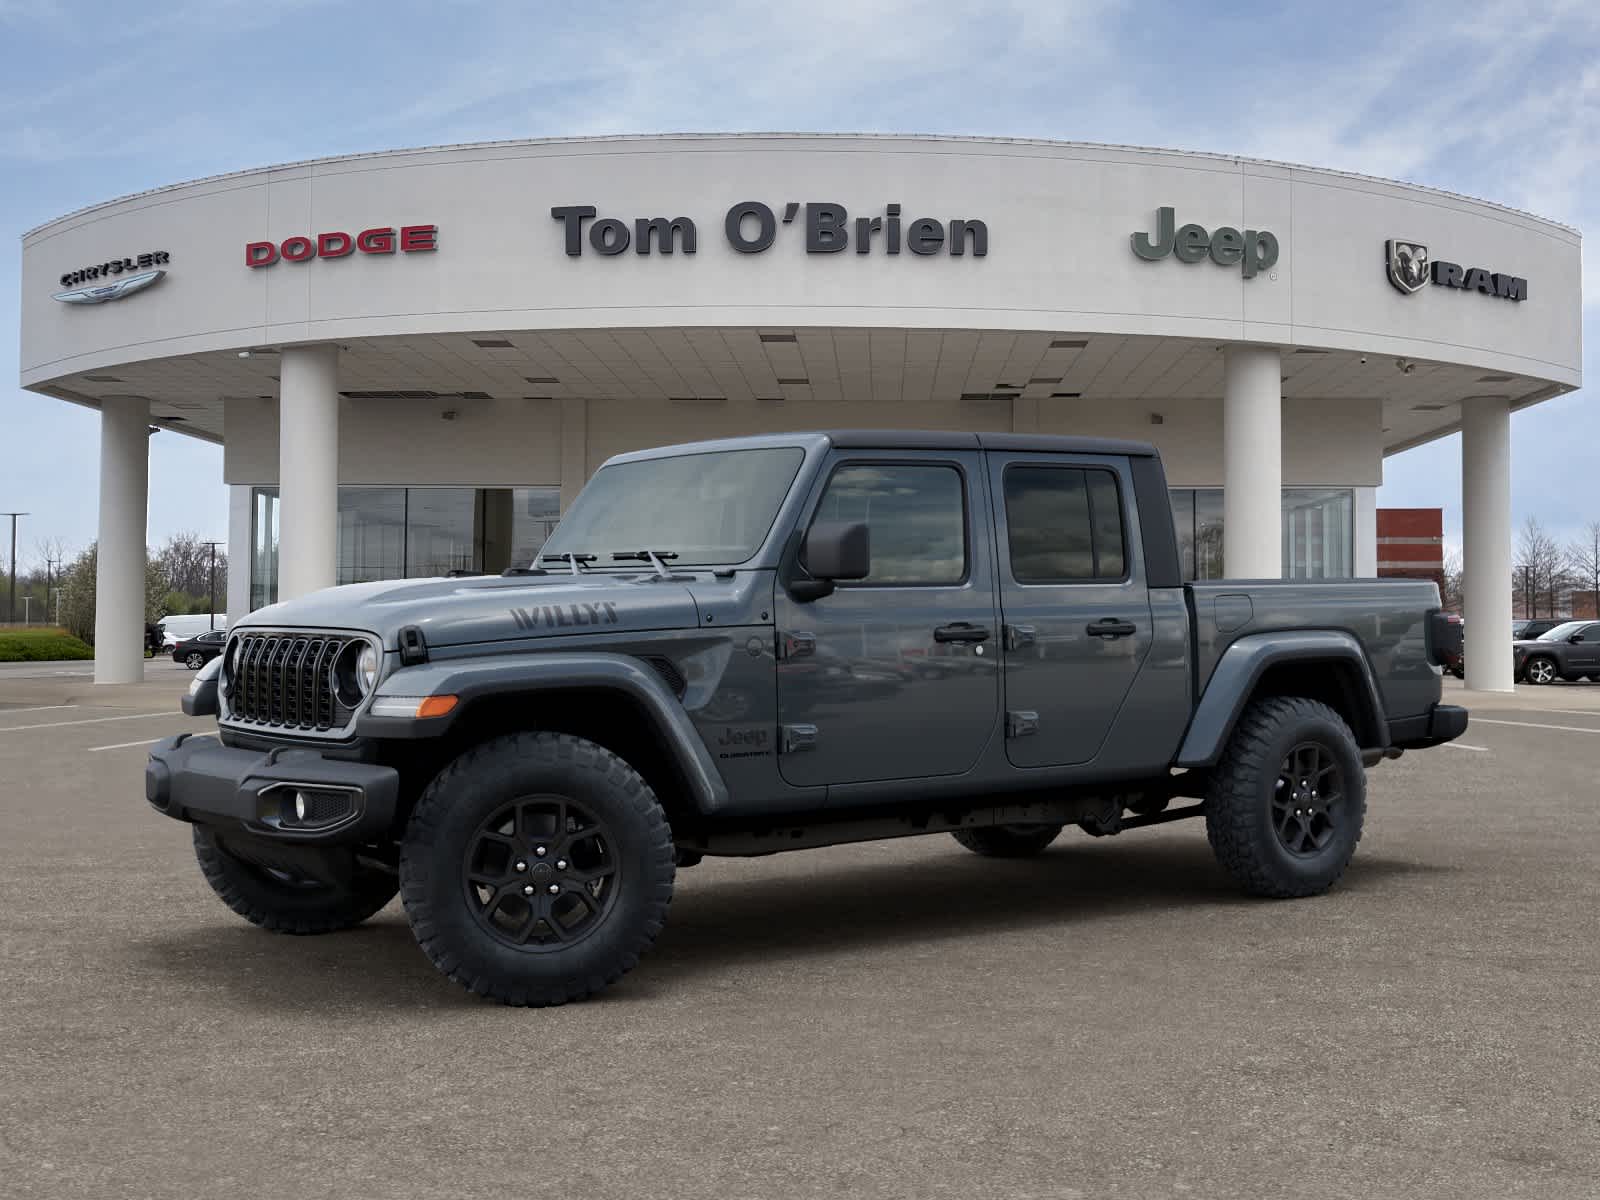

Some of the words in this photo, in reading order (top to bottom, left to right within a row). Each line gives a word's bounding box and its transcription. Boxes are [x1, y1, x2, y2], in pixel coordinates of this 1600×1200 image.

[245, 224, 439, 269] DODGE
[551, 205, 697, 257] Tom
[1130, 206, 1279, 279] Jeep
[60, 250, 170, 287] CHRYSLER
[1430, 261, 1528, 302] RAM
[509, 601, 618, 630] WILLYS
[718, 727, 767, 748] Jeep
